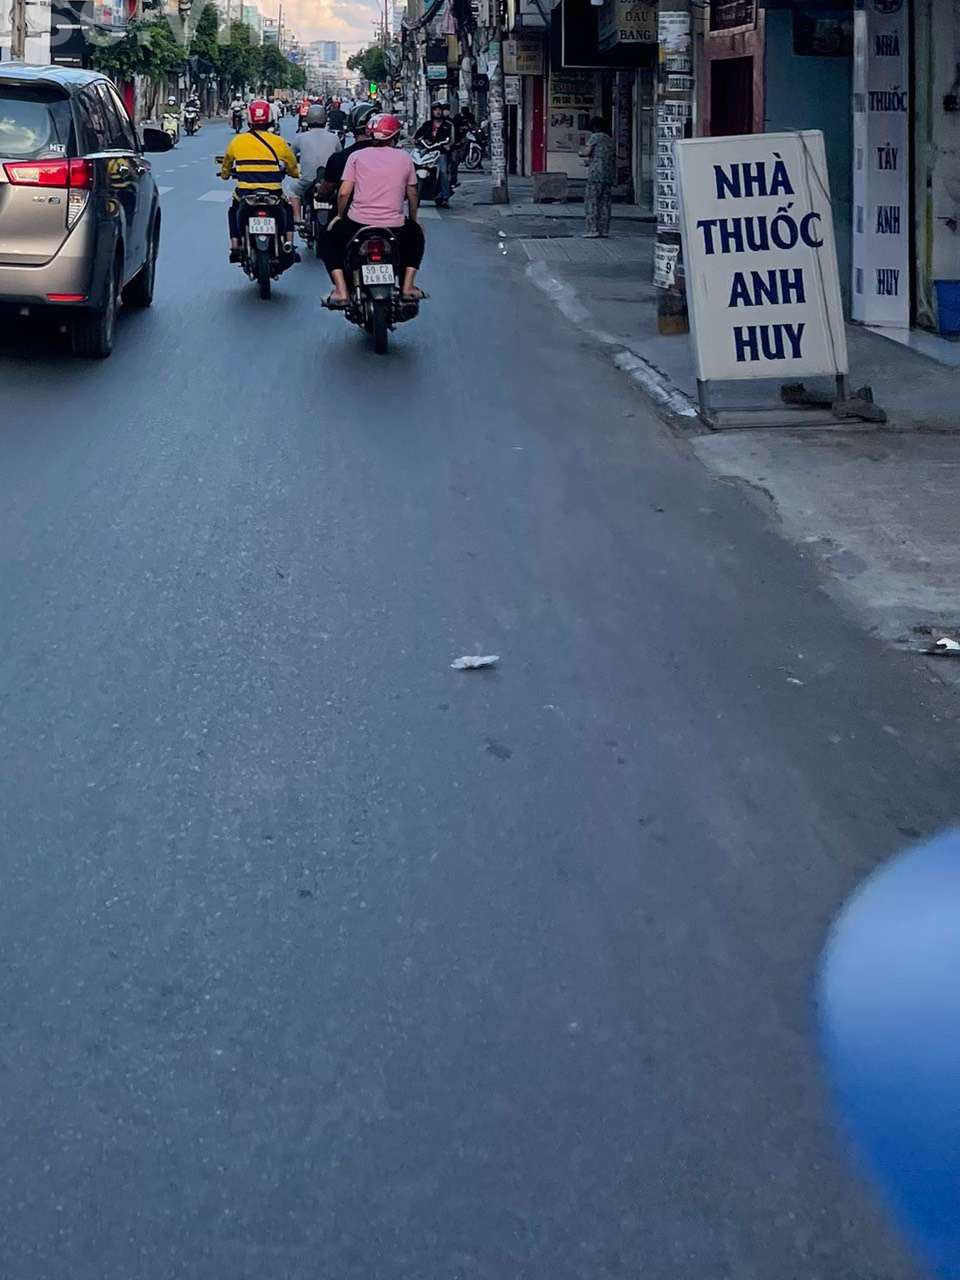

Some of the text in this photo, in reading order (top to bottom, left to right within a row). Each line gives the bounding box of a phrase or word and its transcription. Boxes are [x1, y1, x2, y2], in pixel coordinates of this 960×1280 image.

[876, 29, 900, 57] NHÀ
[868, 85, 908, 113] THUỐC
[713, 152, 795, 200] NHÀ
[695, 202, 824, 256] THUỐC
[876, 205, 900, 235] ANH
[728, 267, 807, 308] ANH
[876, 268, 900, 297] HUY
[733, 322, 807, 363] HUY
